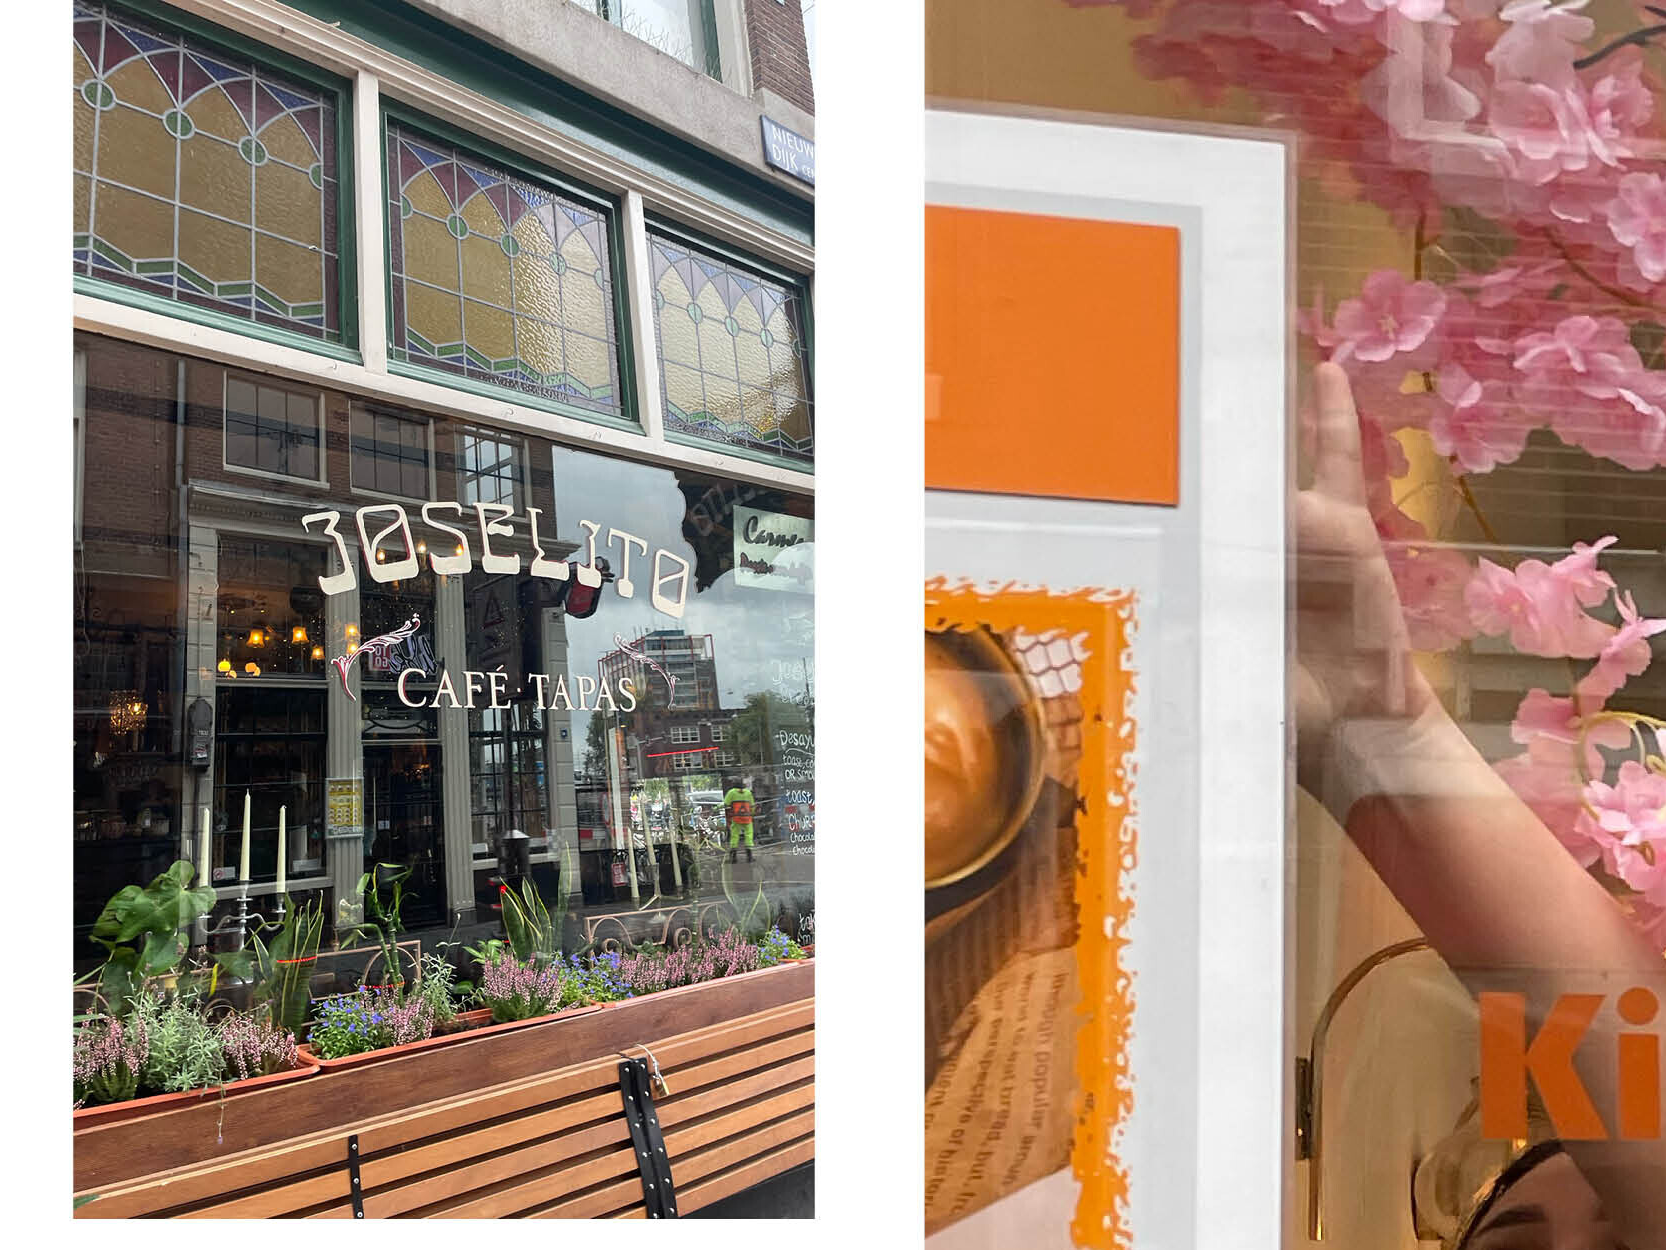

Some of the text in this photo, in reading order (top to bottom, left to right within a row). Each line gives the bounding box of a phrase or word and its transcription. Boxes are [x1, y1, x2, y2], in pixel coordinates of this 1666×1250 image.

[773, 144, 798, 170] DIJK
[301, 501, 690, 618] JOSELITO
[397, 664, 636, 712] CAFÉ TAPAS
